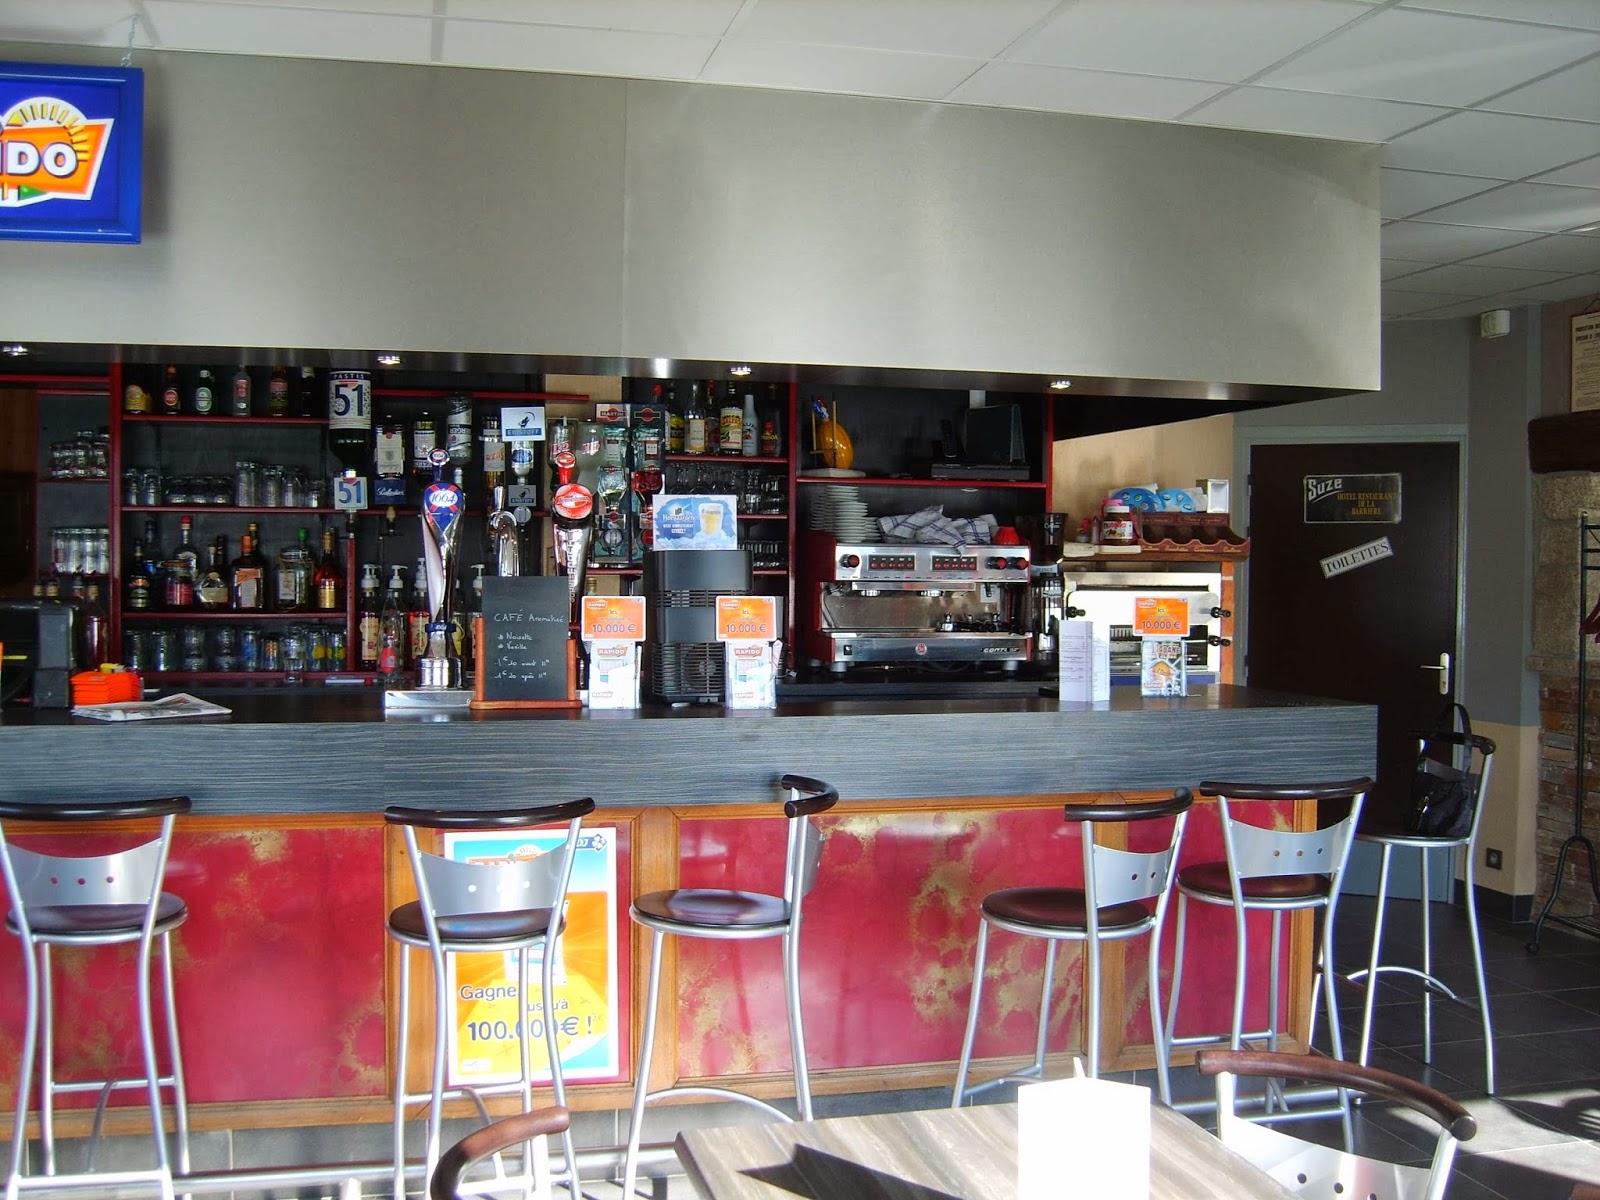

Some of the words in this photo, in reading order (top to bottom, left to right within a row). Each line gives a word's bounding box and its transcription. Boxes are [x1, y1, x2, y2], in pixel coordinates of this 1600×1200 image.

[0, 141, 78, 176] DO
[334, 384, 364, 417] 51
[338, 481, 362, 504] 51
[1308, 478, 1342, 501] Suze
[430, 492, 457, 503] 1664
[1324, 541, 1390, 573] TOILETTES
[493, 608, 524, 622] CAFÉ
[592, 623, 626, 633] 10.000
[627, 623, 636, 633] €
[726, 623, 758, 633] 10.000
[759, 623, 767, 633] €
[1142, 621, 1172, 629] 10.000
[1173, 620, 1182, 630] €
[460, 985, 518, 1001] Gagne
[527, 1001, 568, 1012] usu'à
